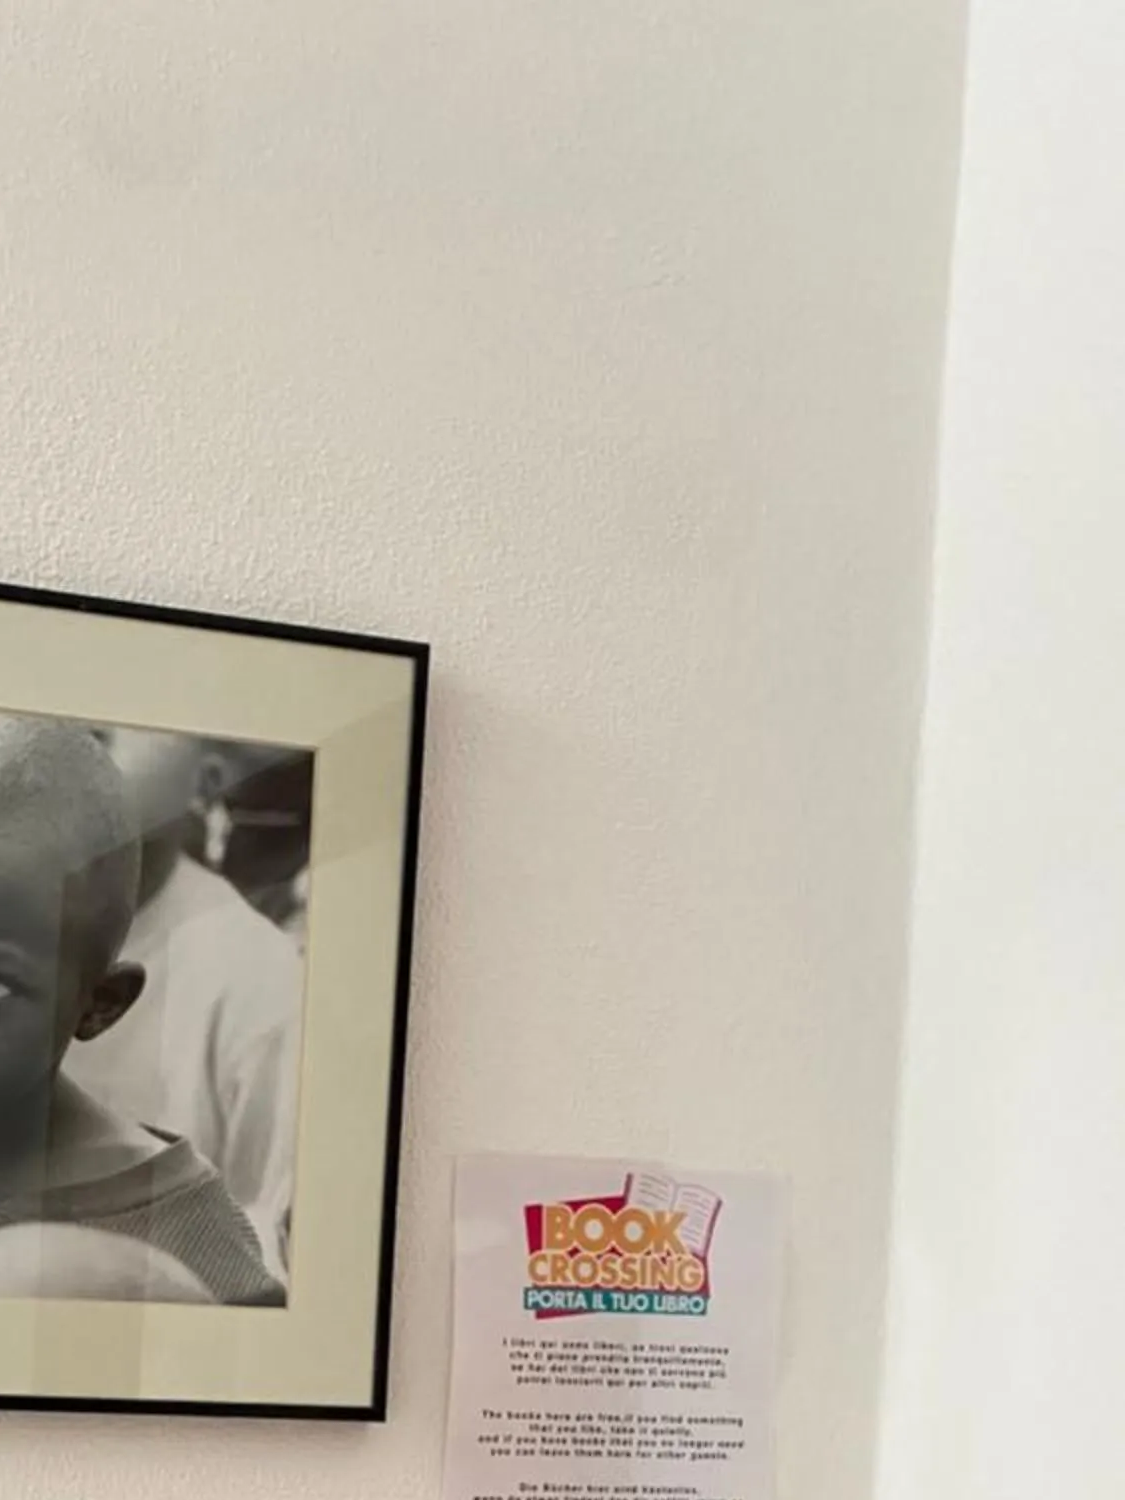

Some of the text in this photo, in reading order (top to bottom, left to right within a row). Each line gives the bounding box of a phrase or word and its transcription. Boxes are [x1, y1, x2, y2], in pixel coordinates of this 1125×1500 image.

[544, 1205, 688, 1254] BOOK
[527, 1253, 704, 1289] CROSSING
[527, 1290, 705, 1314] PORTA IL TUO LIBRO
